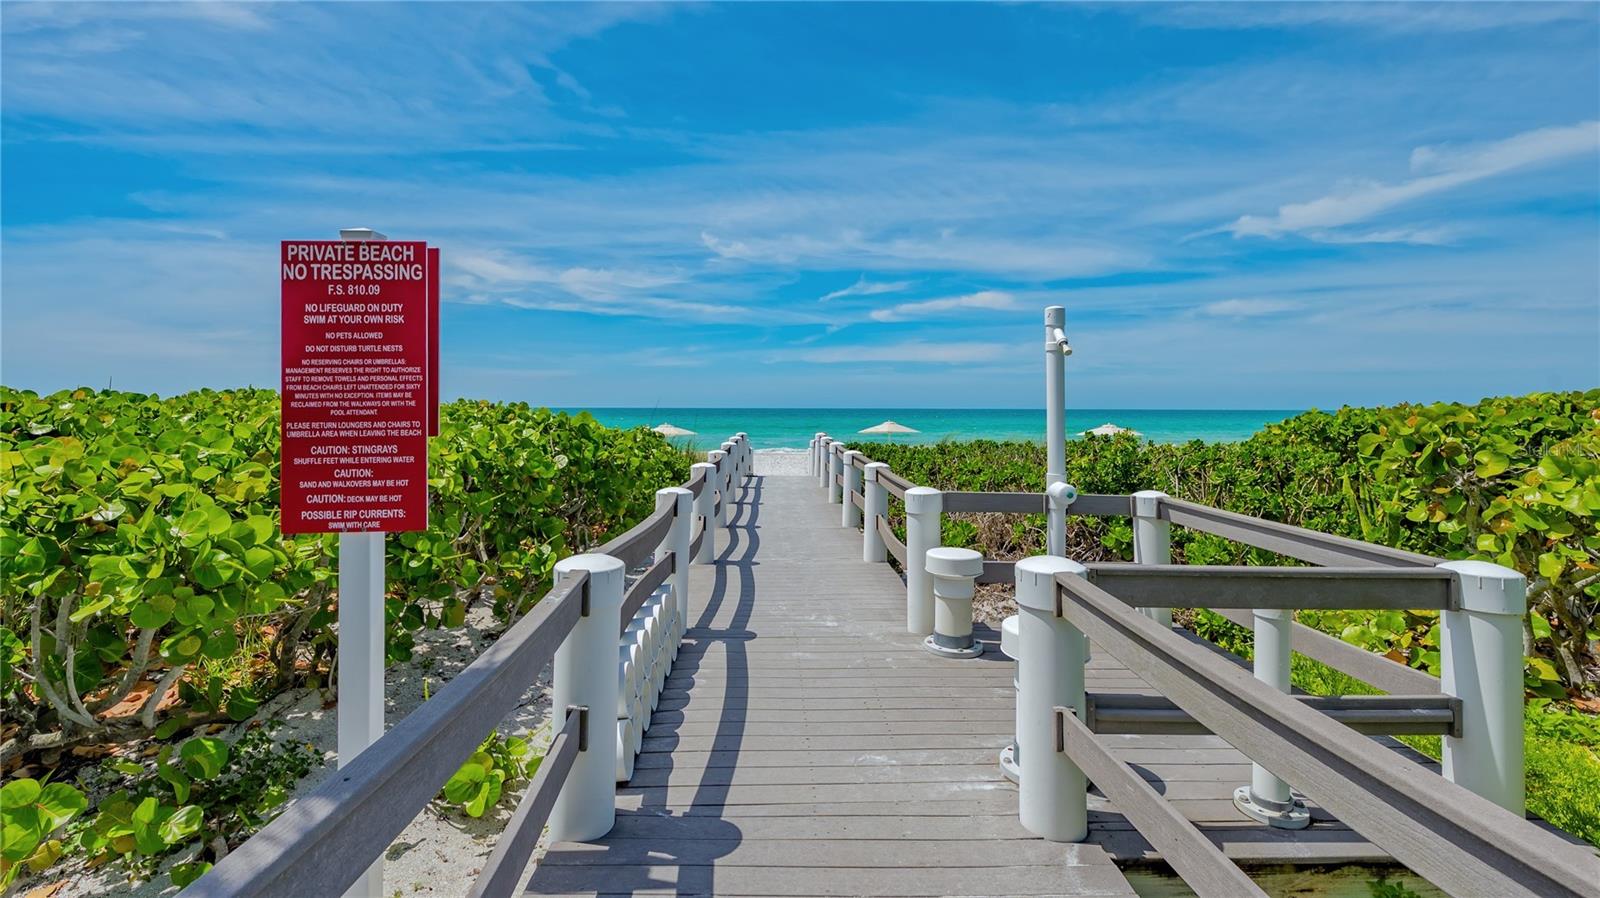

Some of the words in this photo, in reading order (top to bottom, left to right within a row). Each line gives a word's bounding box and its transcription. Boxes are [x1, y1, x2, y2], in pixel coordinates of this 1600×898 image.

[287, 245, 355, 261] PRIVATE
[359, 245, 414, 261] BEACH
[283, 264, 307, 280] NO
[310, 264, 423, 280] TRESPASSING
[328, 285, 345, 295] F.S.
[348, 285, 380, 295] 810.09
[305, 304, 318, 312] NO
[319, 304, 366, 312] LIFEGUARD
[367, 304, 379, 312] ON
[381, 304, 403, 312] DUTY
[303, 315, 326, 324] SWIM
[327, 315, 338, 324] AT
[339, 315, 362, 324] YOUR
[363, 315, 383, 324] OWN
[385, 315, 404, 324] RISK
[321, 430, 339, 438] AREA
[311, 446, 350, 455] CAUTION:
[352, 445, 398, 454] STINGRAYS
[293, 457, 322, 465] SHUFFLE
[393, 456, 415, 464] WATER
[334, 469, 374, 478] CAUTION:
[332, 480, 372, 488] WALKOVERS
[306, 494, 347, 504] CAUTION:
[301, 510, 342, 519] POSSIBLE
[343, 510, 358, 519] RIP
[359, 509, 406, 518] CURRENTS:
[328, 521, 345, 529] SWIM
[346, 521, 363, 529] WITH
